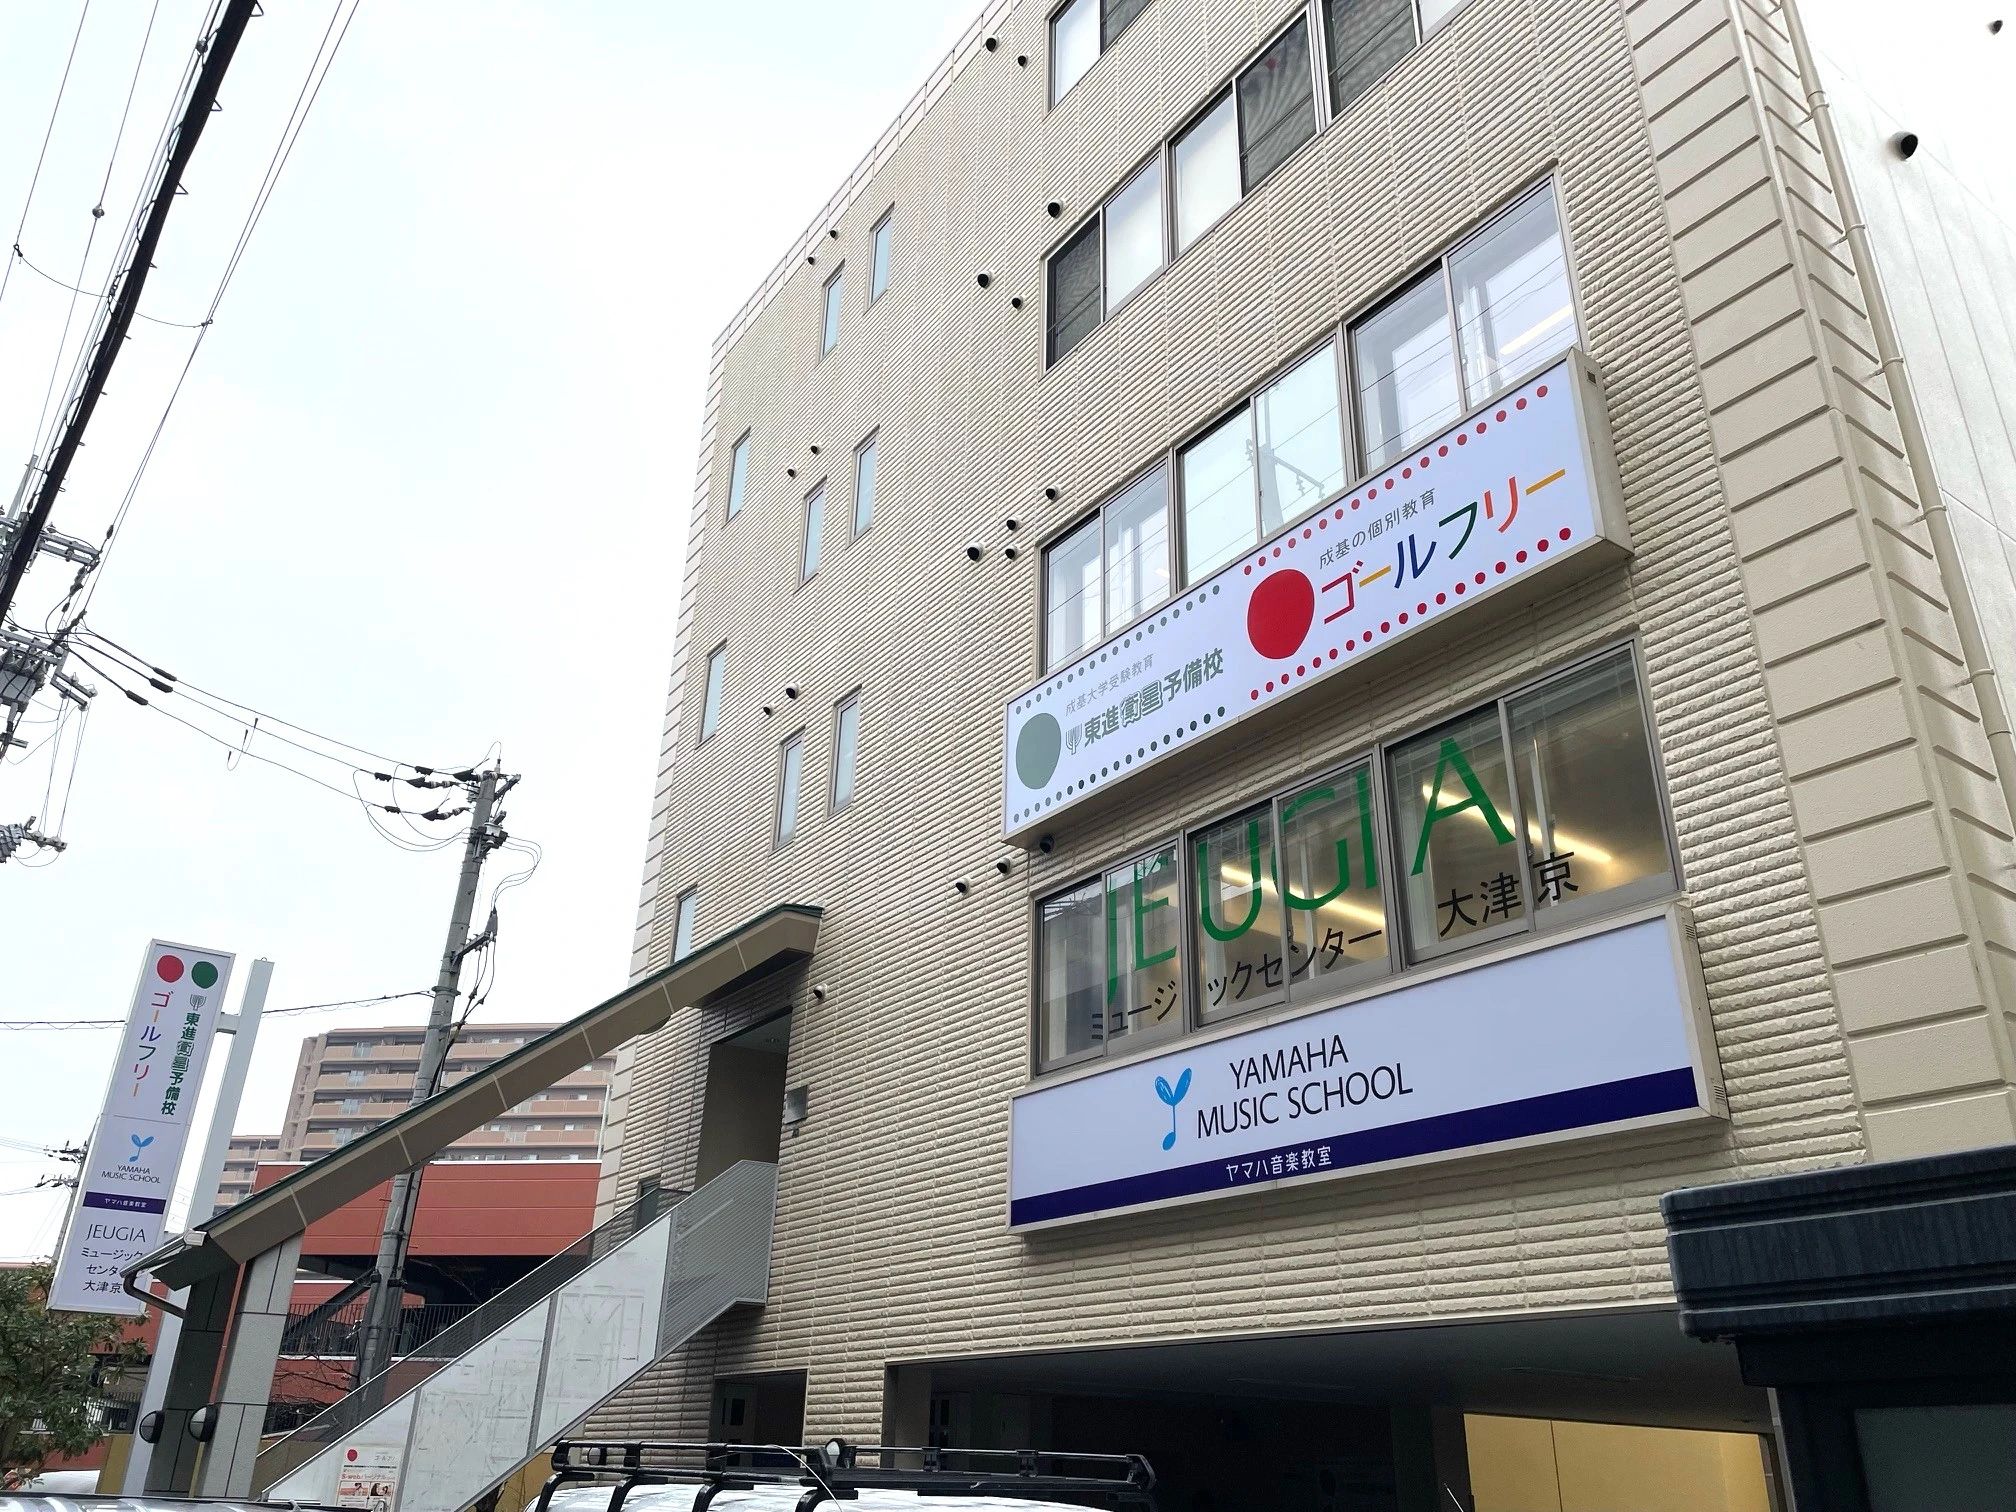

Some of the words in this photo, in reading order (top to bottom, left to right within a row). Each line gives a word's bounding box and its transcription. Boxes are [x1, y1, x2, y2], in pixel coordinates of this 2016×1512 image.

[1319, 488, 1435, 569] 成基の個別教育
[1321, 469, 1566, 625] ゴールフリー
[1065, 653, 1154, 716] 成基大学受験教育
[1084, 647, 1224, 747] 東進衛星予備校
[1106, 738, 1516, 1006] JEUGIA
[1437, 851, 1579, 937] 大津京
[133, 990, 174, 1097] ゴールフリー
[161, 1012, 201, 1116] 東進衛星予備校
[1229, 1034, 1349, 1090] YAMAHA
[1197, 1092, 1280, 1139] MUSIC
[1287, 1062, 1413, 1119] SCHOOL
[101, 1170, 127, 1181] MUSIC
[129, 1173, 161, 1184] SCHOOL
[117, 1164, 151, 1175] YAMAHA
[1226, 1145, 1332, 1182] ヤマハ音楽教室
[85, 1223, 146, 1243] JEUGIA
[82, 1279, 123, 1294] 大津京
[86, 1263, 119, 1276] センタ
